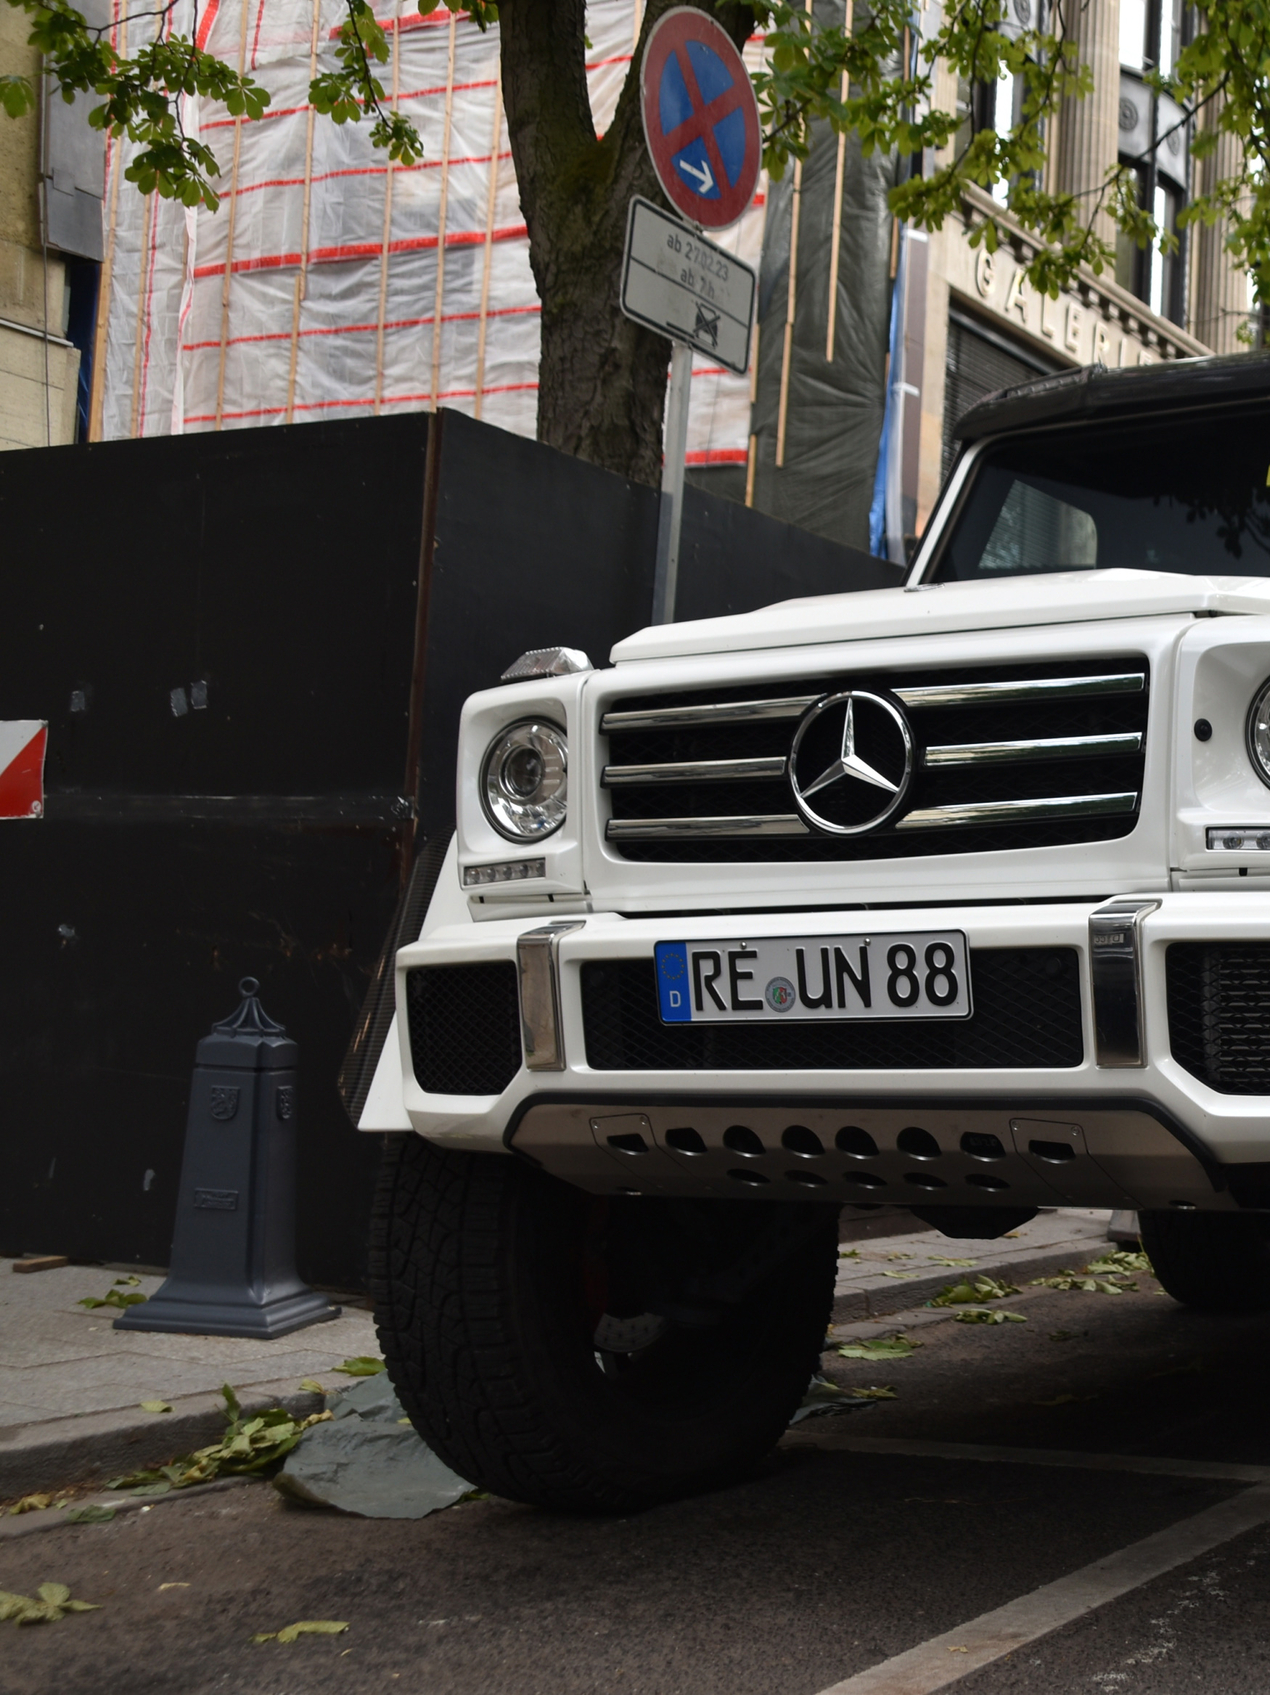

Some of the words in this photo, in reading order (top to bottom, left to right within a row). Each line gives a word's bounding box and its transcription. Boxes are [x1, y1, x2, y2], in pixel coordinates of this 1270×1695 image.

[667, 234, 682, 253] ab
[680, 268, 695, 288] ab
[692, 949, 764, 1012] RE
[796, 944, 872, 1010] UN
[886, 942, 959, 1008] 88
[669, 990, 681, 1008] D
